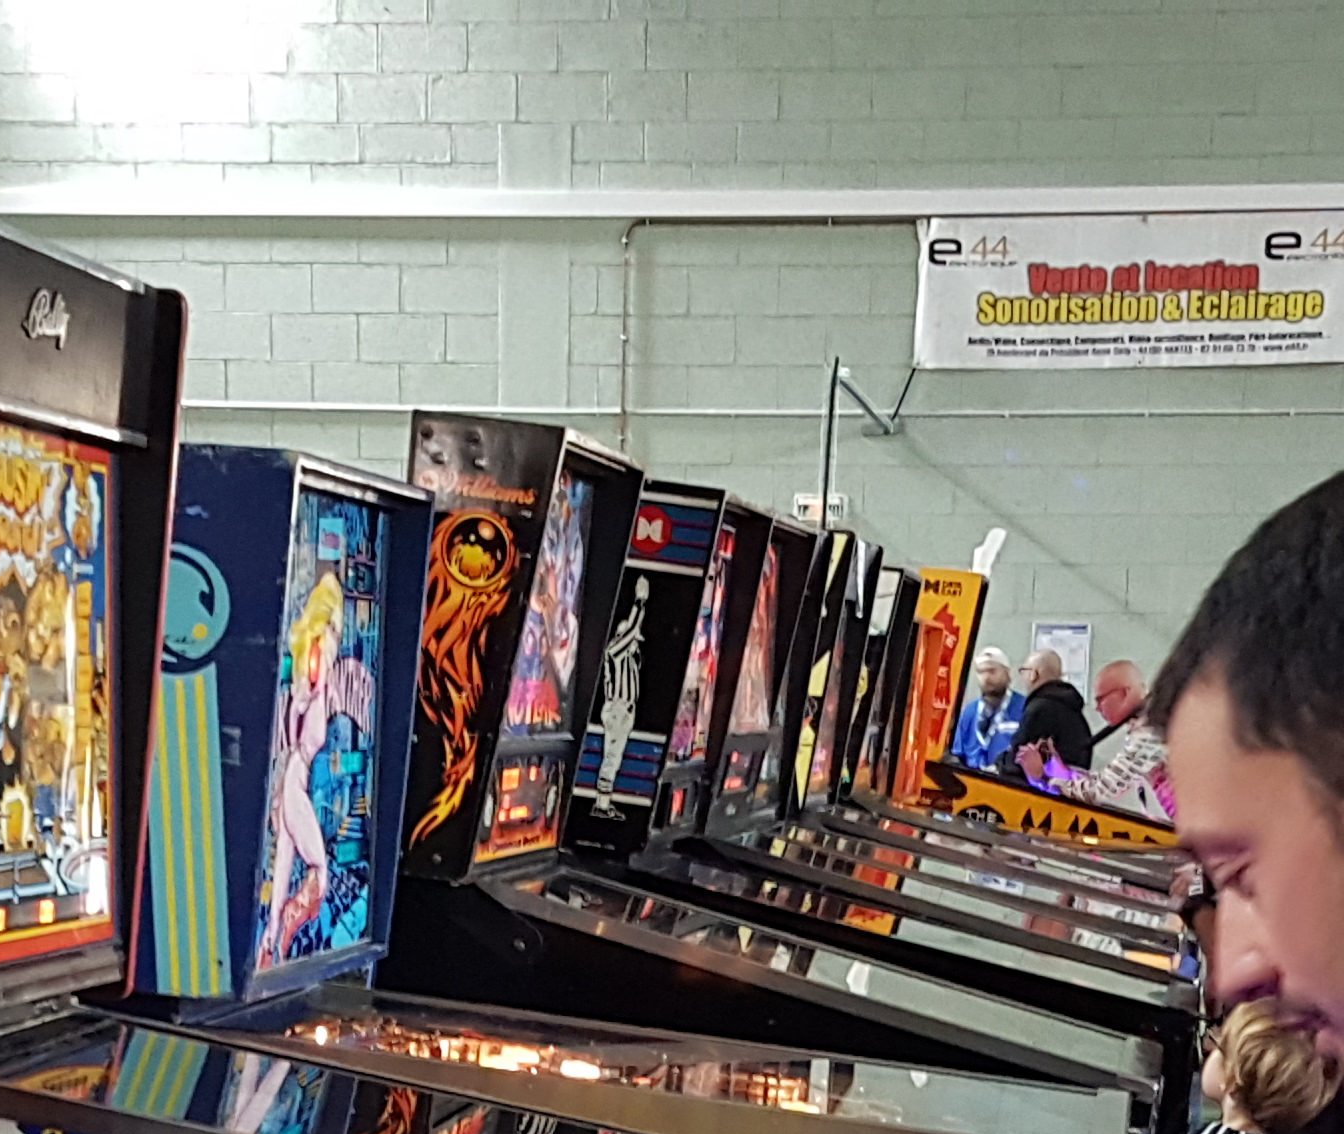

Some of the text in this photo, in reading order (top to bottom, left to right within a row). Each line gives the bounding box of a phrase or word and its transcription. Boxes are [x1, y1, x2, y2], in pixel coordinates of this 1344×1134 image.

[1027, 259, 1260, 295] Vente et location
[21, 287, 70, 350] Bally
[977, 288, 1325, 325] Sonorisation & Eclairage
[965, 808, 998, 824] THE
